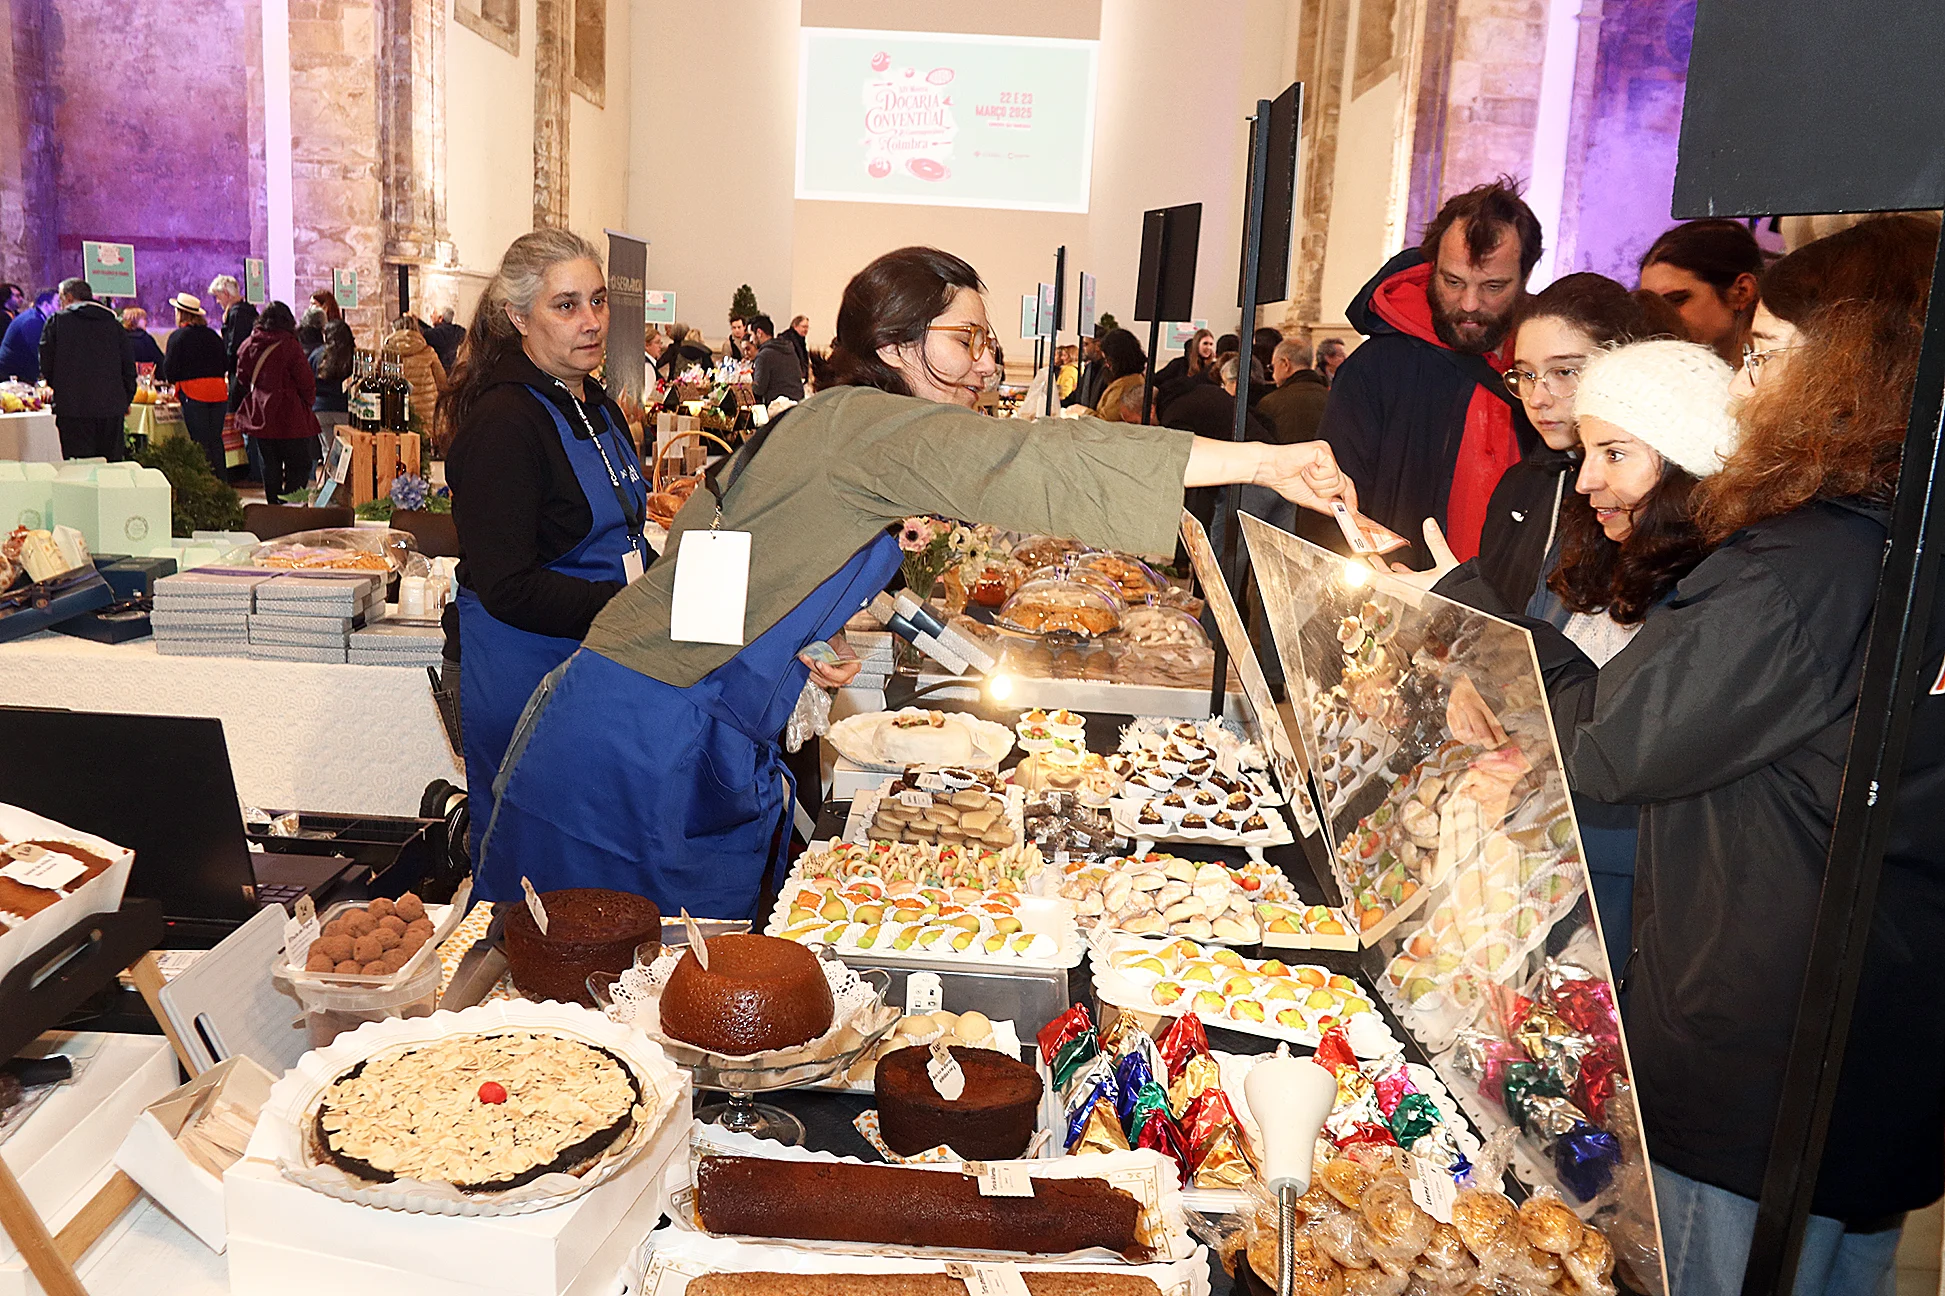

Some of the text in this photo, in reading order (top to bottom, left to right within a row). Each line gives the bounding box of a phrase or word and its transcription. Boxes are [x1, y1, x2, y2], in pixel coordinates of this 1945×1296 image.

[1000, 91, 1034, 105] 22 E 23
[865, 106, 951, 134] CONVENTUAL
[975, 104, 1033, 121] MARÇO 2025
[881, 136, 928, 154] Coimbra
[1354, 537, 1365, 549] 10
